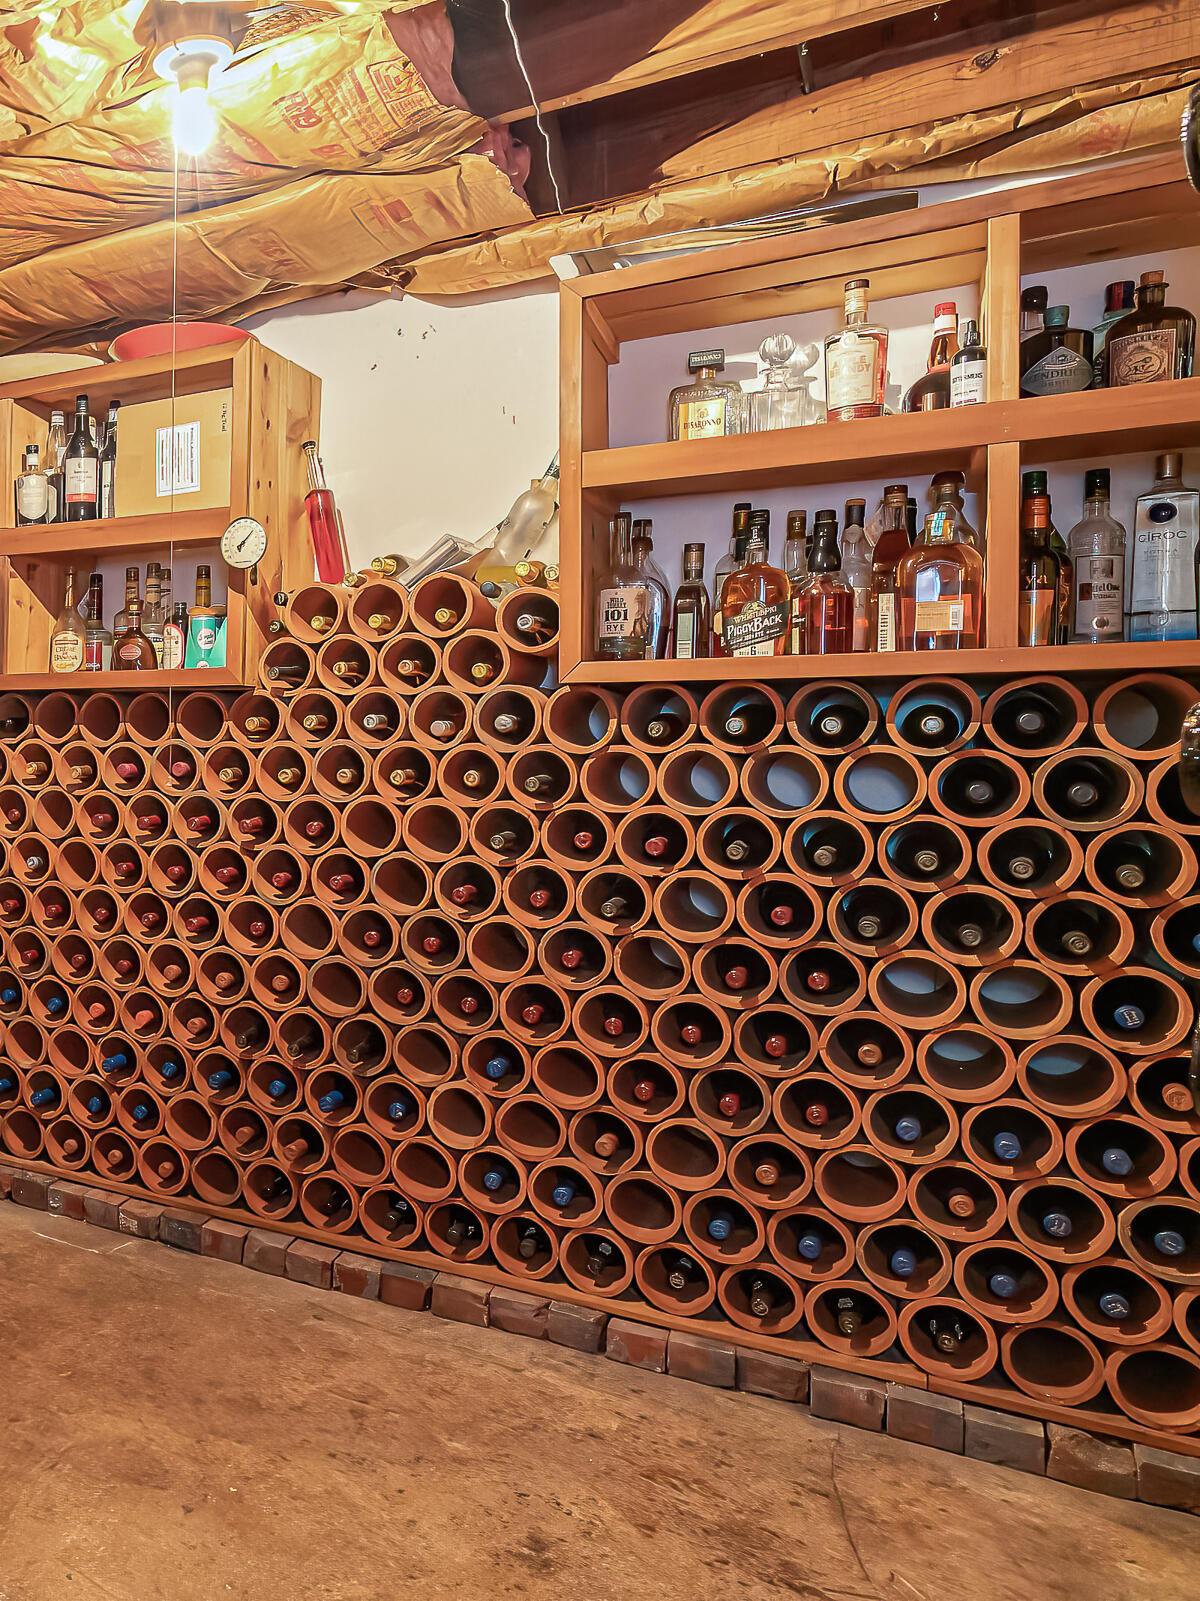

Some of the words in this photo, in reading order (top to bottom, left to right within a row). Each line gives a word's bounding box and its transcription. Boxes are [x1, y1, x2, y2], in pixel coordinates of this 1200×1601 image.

[604, 609, 629, 622] 101
[606, 624, 625, 632] RYE
[750, 645, 757, 656] 6
